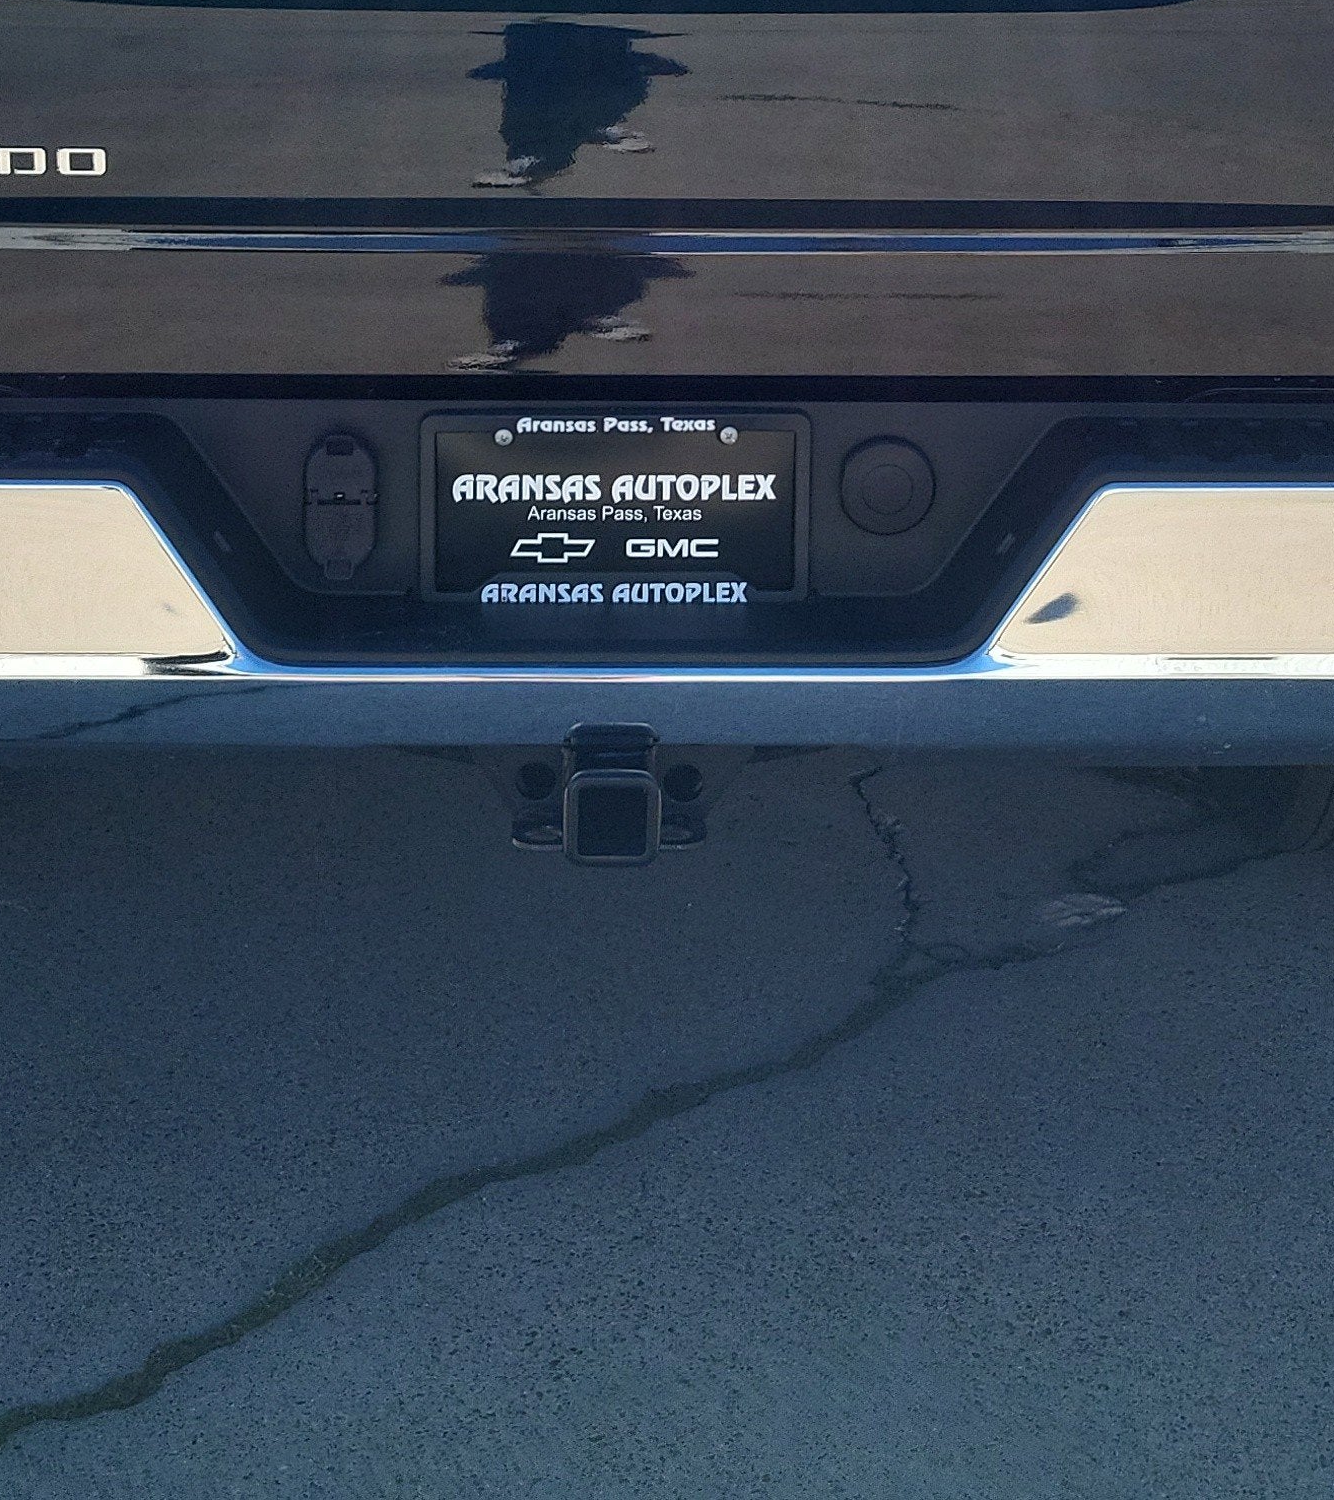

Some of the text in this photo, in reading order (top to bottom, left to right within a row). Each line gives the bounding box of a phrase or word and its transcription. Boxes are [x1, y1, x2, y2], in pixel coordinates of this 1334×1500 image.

[516, 416, 716, 434] Aransas Pass, Texas
[452, 473, 777, 503] ARANSAS AUTOPLEX
[527, 506, 703, 523] Aransas Pass, Texas
[625, 538, 720, 559] GMC
[480, 582, 748, 604] ARANSAS AUTOPLEX
